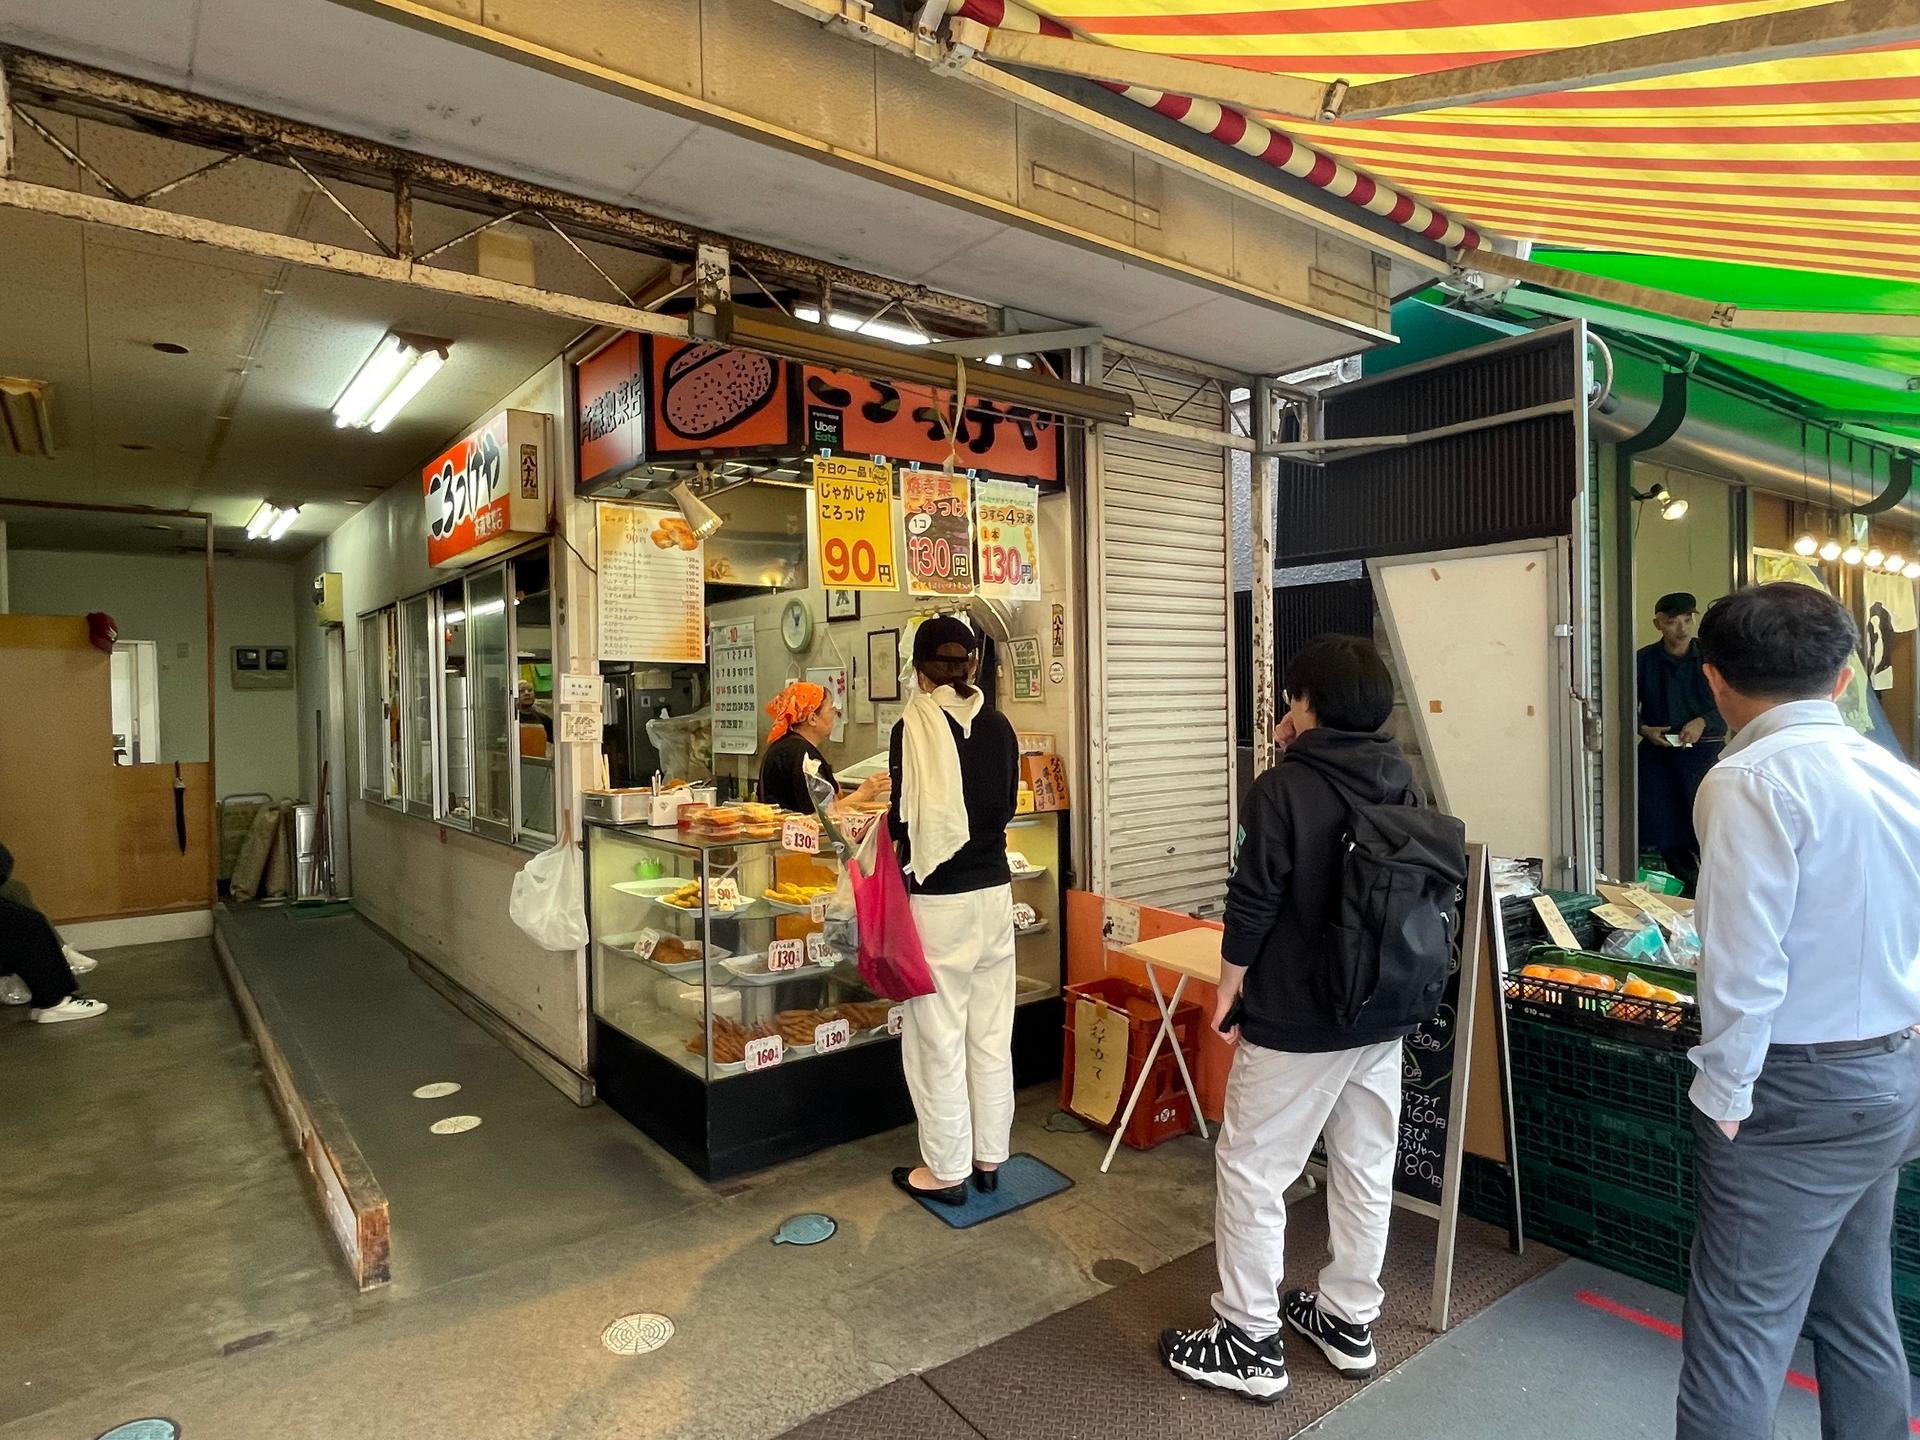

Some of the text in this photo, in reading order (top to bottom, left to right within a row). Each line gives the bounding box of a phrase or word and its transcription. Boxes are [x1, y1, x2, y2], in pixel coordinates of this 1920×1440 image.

[815, 421, 836, 432] Uber
[815, 432, 837, 443] Eats
[821, 483, 887, 503] じゃがじゃが
[822, 504, 865, 522] ころっけ
[825, 537, 892, 583] 90円
[909, 536, 968, 577] 130円
[982, 546, 1033, 584] 130円
[794, 832, 812, 848] 130
[718, 888, 730, 900] 90
[777, 950, 795, 967] 130
[826, 1031, 842, 1048] 130
[756, 1048, 774, 1065] 160
[1406, 1105, 1446, 1129] 160円
[1397, 1151, 1442, 1188] 180円
[1247, 1366, 1274, 1377] FILA
